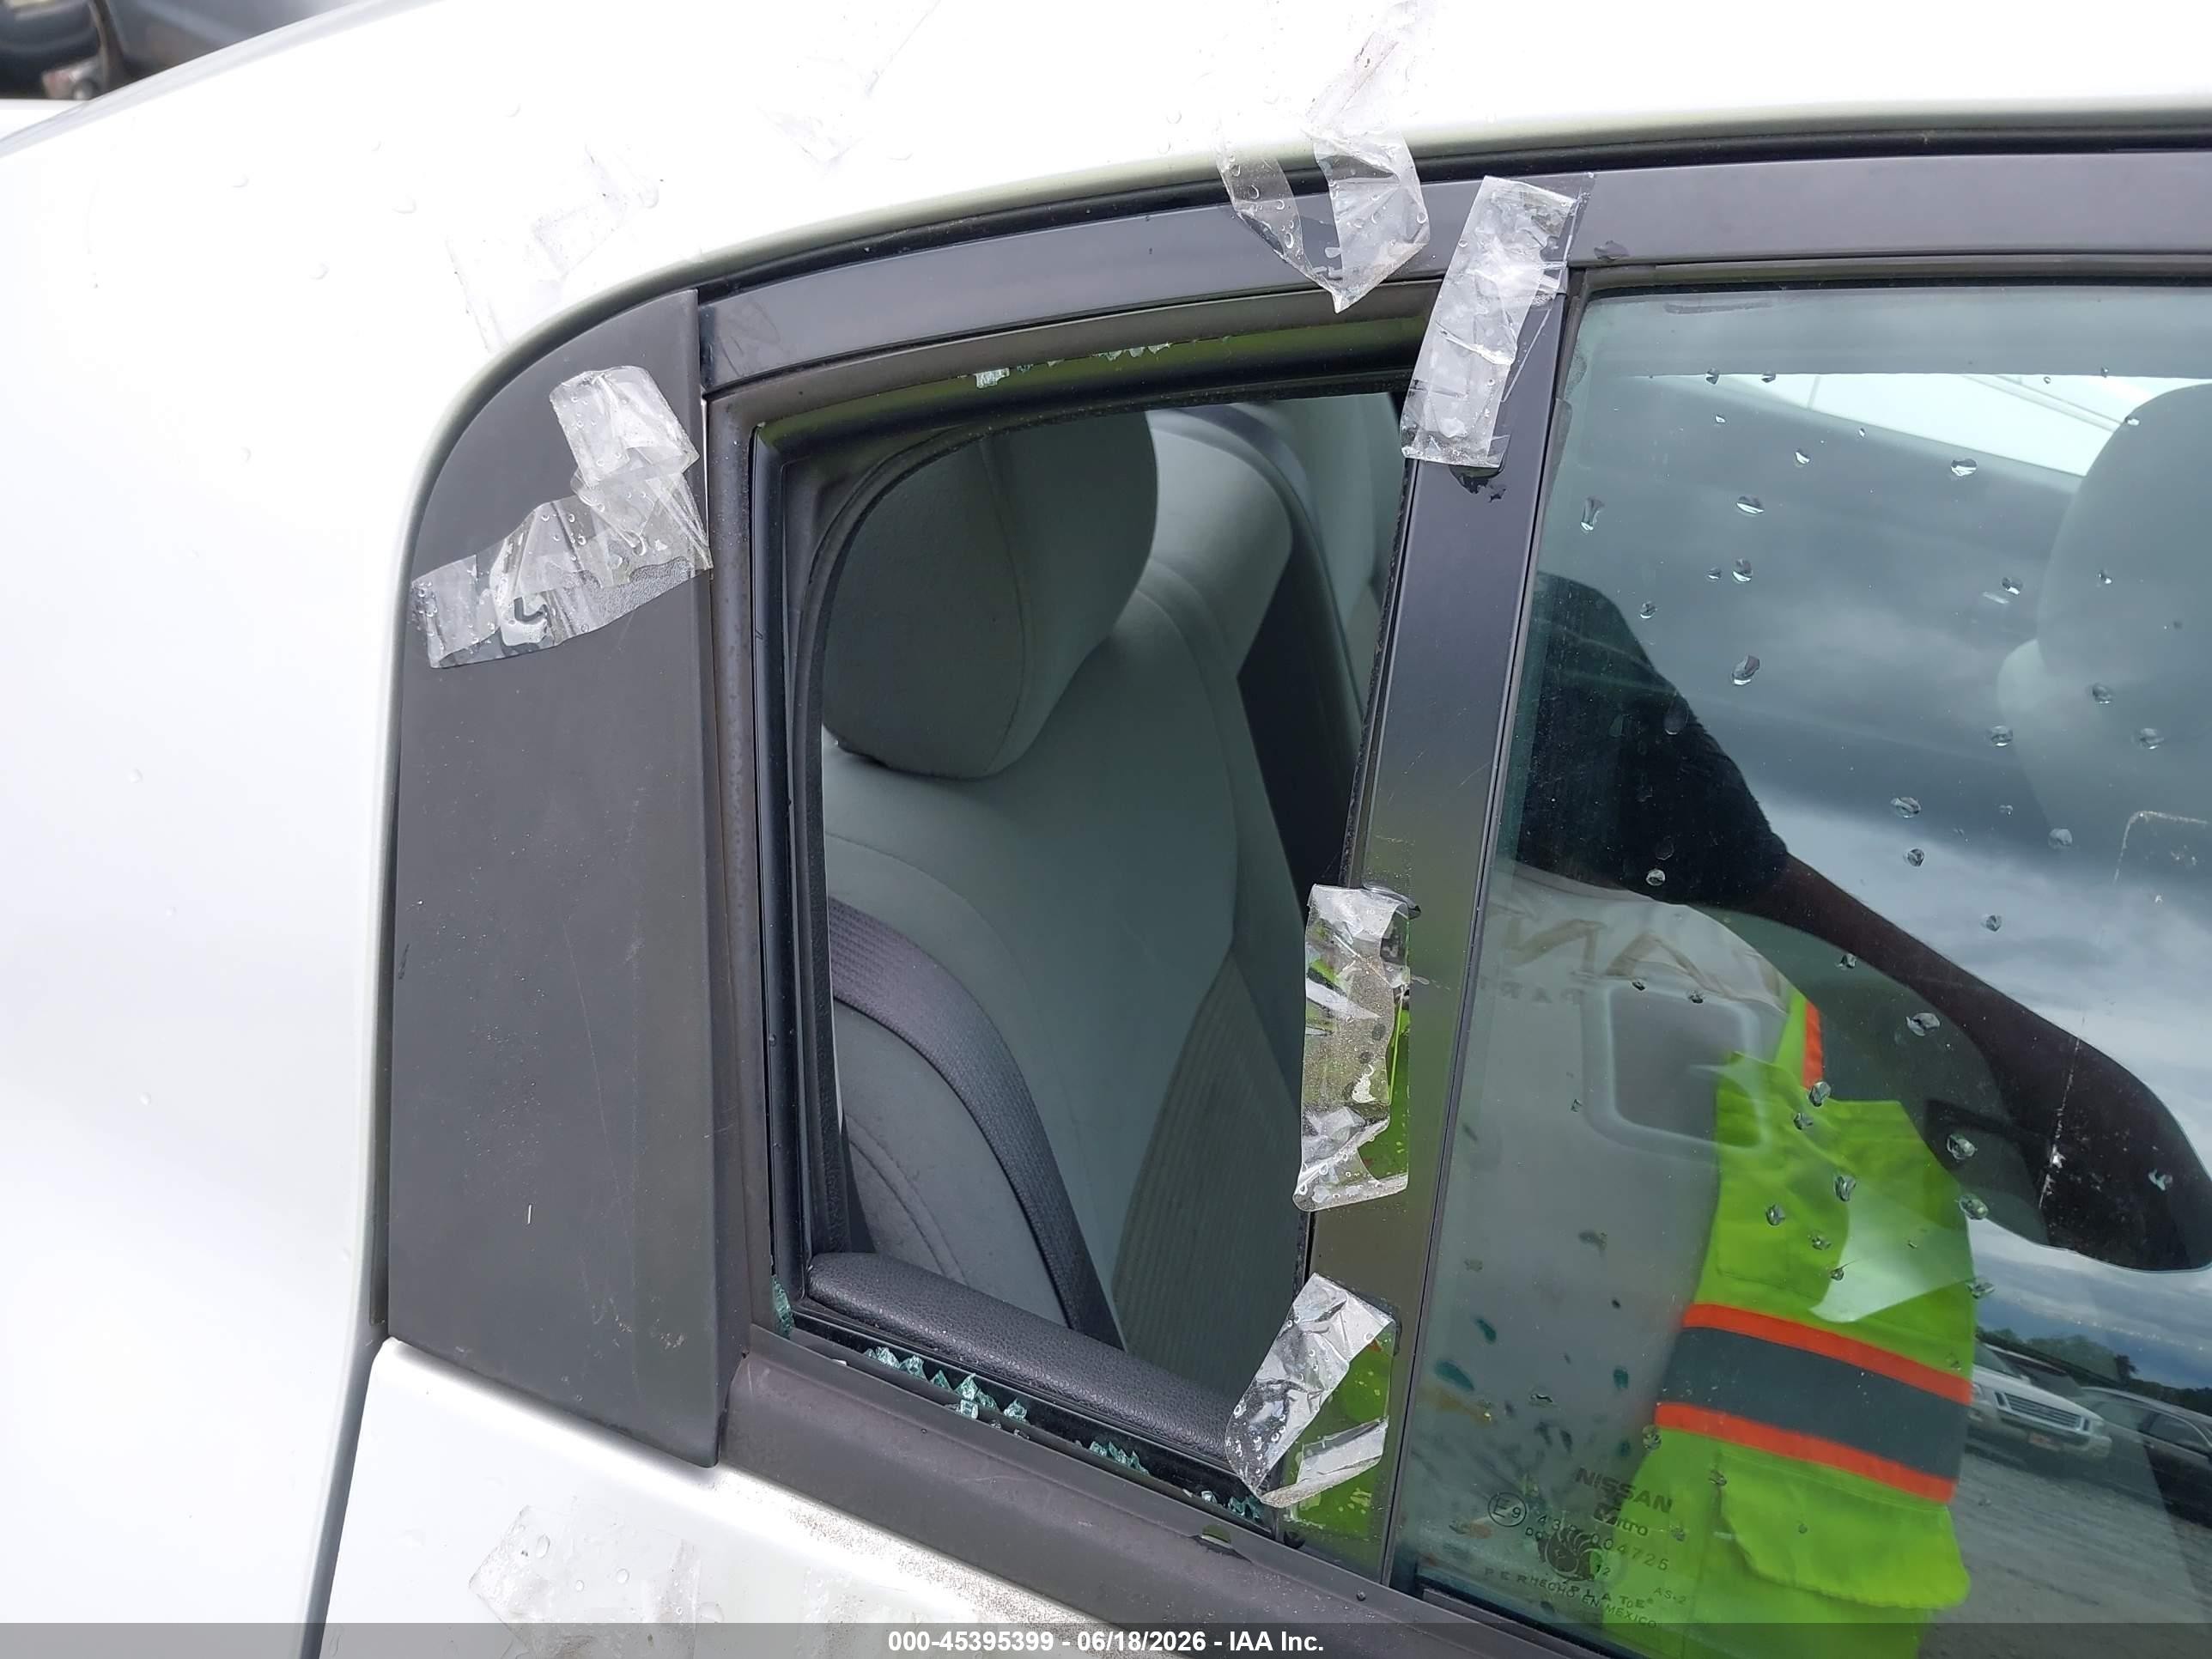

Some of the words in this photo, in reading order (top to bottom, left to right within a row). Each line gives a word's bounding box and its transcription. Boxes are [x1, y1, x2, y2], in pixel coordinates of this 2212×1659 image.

[1574, 1467, 1673, 1514] NISSAN
[1581, 1595, 1600, 1608] EN
[1607, 1603, 1657, 1629] MEXICO
